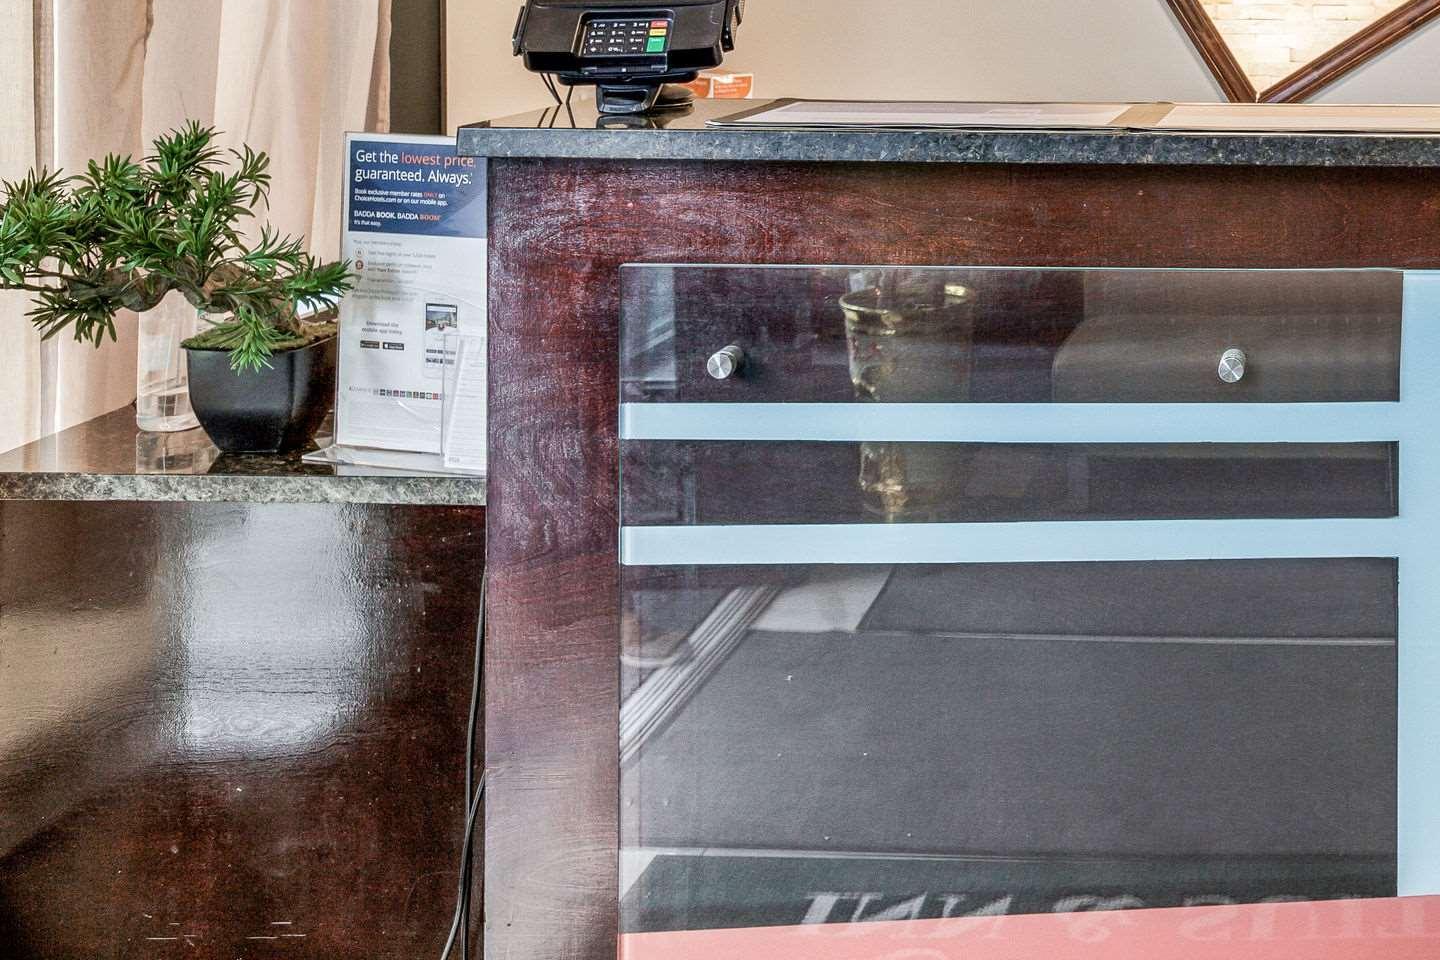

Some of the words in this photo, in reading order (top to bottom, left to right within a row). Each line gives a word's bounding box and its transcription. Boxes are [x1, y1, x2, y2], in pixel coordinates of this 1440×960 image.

[355, 149, 377, 163] Get
[379, 150, 399, 164] the
[400, 151, 441, 166] lowest
[444, 155, 477, 169] price,
[354, 168, 425, 183] guaranteed.
[354, 187, 367, 195] Book
[389, 189, 410, 197] member
[420, 198, 437, 206] mobile
[354, 210, 376, 218] BADDA
[376, 211, 397, 219] BOOK.
[397, 212, 419, 220] BADDA
